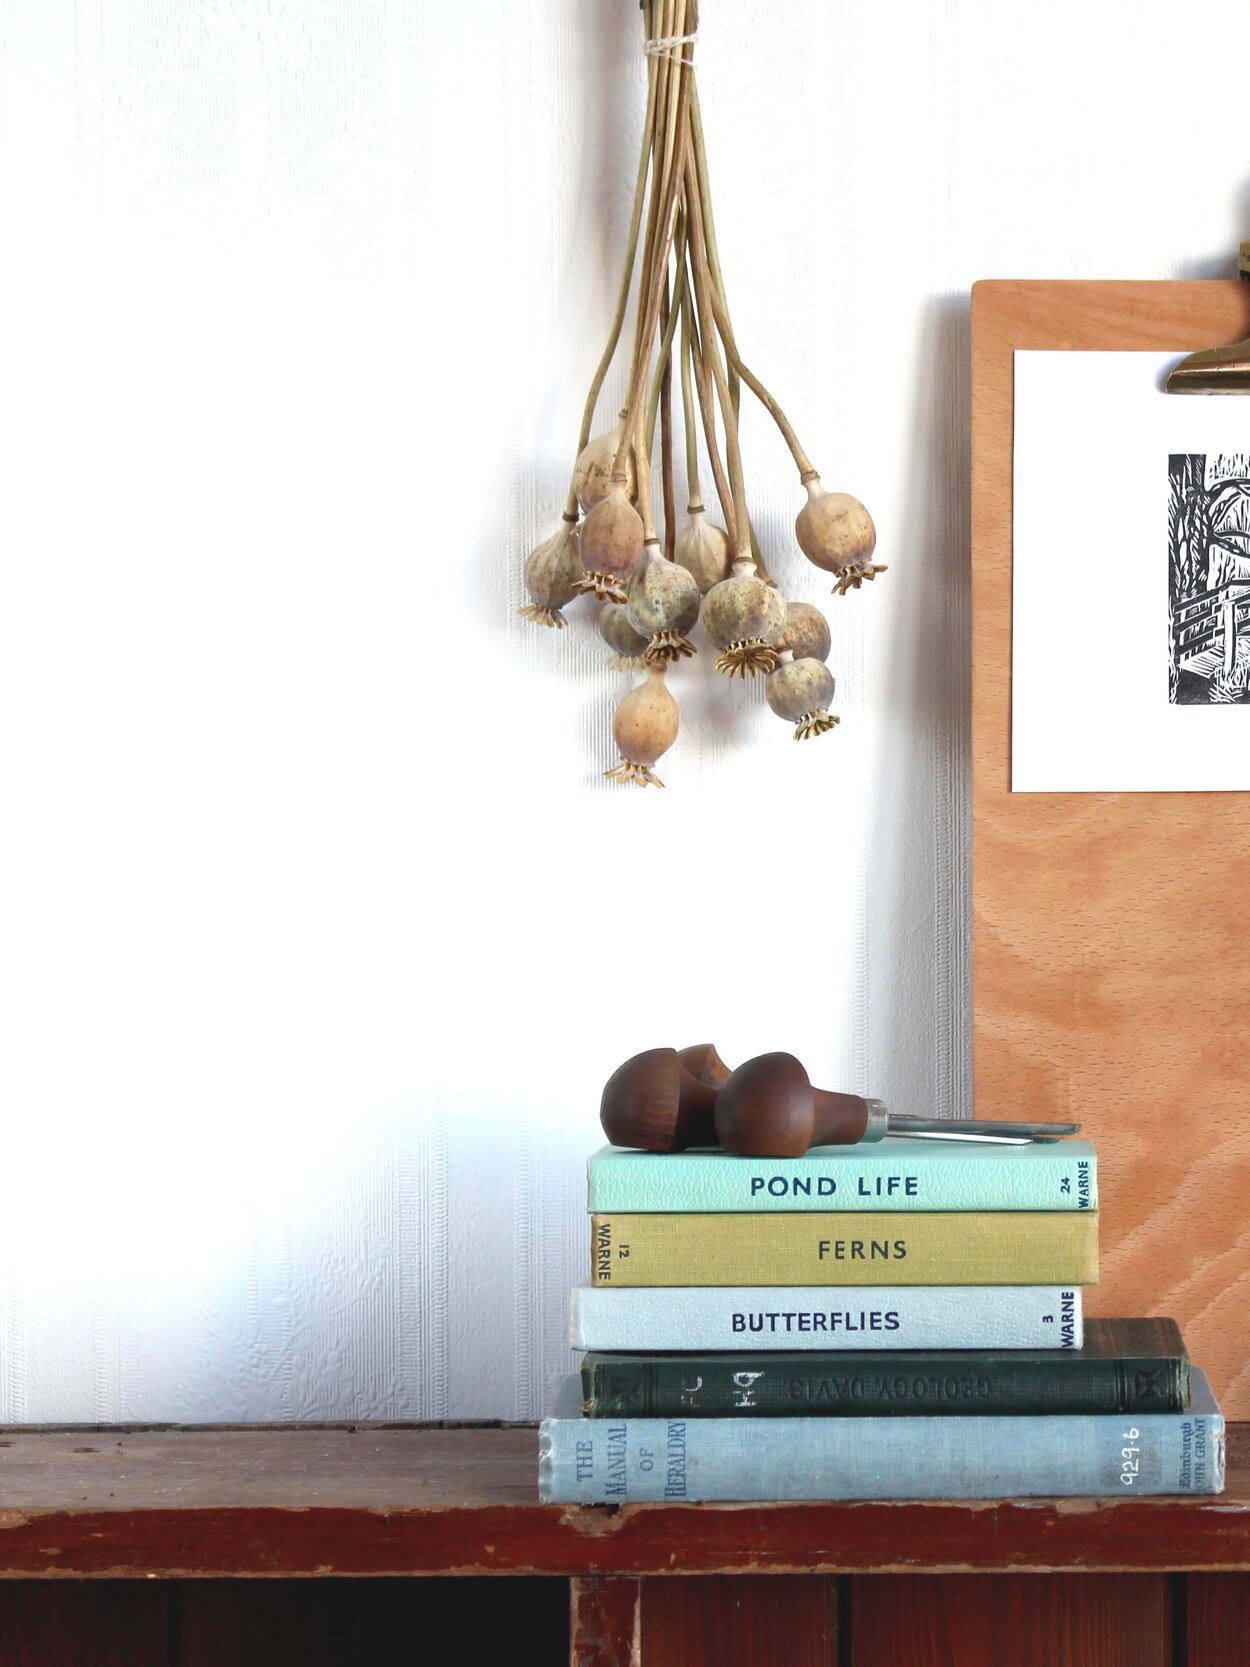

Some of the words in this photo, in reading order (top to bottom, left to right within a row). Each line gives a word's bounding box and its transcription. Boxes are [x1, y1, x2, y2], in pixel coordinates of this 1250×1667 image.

[750, 1176, 837, 1197] POND
[858, 1176, 918, 1196] LIFE
[1060, 1176, 1071, 1194] 24
[1077, 1160, 1090, 1210] WARNE
[599, 1223, 611, 1280] WARNE
[618, 1243, 630, 1259] 12
[818, 1240, 907, 1260] FERNS
[732, 1311, 900, 1333] BUTTERFLIES
[1042, 1314, 1054, 1323] 3
[1060, 1291, 1076, 1348] WARNE
[1120, 1427, 1140, 1486] 929.6
[1194, 1417, 1206, 1458] GRANT
[576, 1439, 594, 1484] THE
[605, 1423, 628, 1497] MANUAL
[639, 1447, 654, 1473] OF
[664, 1420, 687, 1498] HERALDRY
